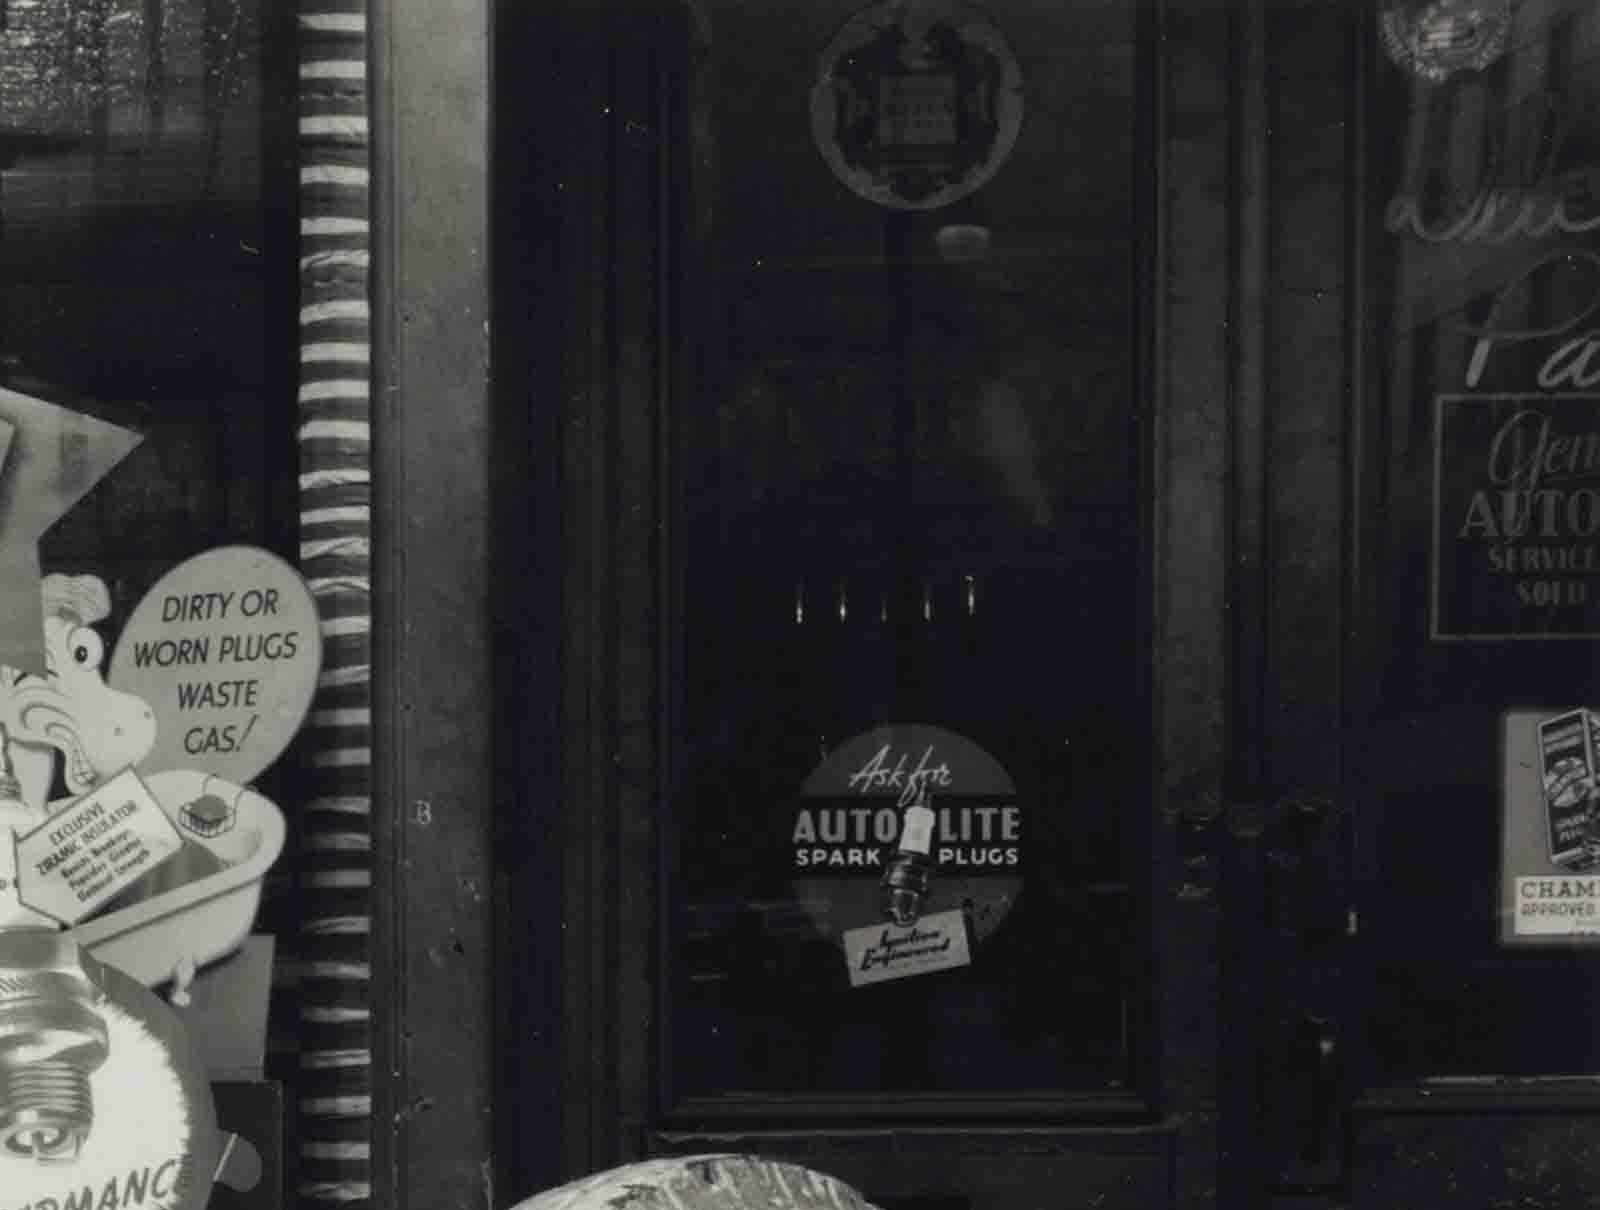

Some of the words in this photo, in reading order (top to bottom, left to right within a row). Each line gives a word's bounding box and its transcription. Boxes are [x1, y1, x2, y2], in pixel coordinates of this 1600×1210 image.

[162, 590, 236, 622] DIRTY
[240, 588, 280, 617] OR
[134, 637, 209, 669] WORN
[218, 631, 299, 663] PLUGS
[177, 680, 259, 711] WASTE
[184, 714, 260, 755] GAS!
[848, 743, 905, 793] Ask
[897, 744, 953, 808] for
[795, 848, 881, 866] SPARK
[938, 847, 1019, 865] PLUGS
[1521, 880, 1600, 898] CHAM
